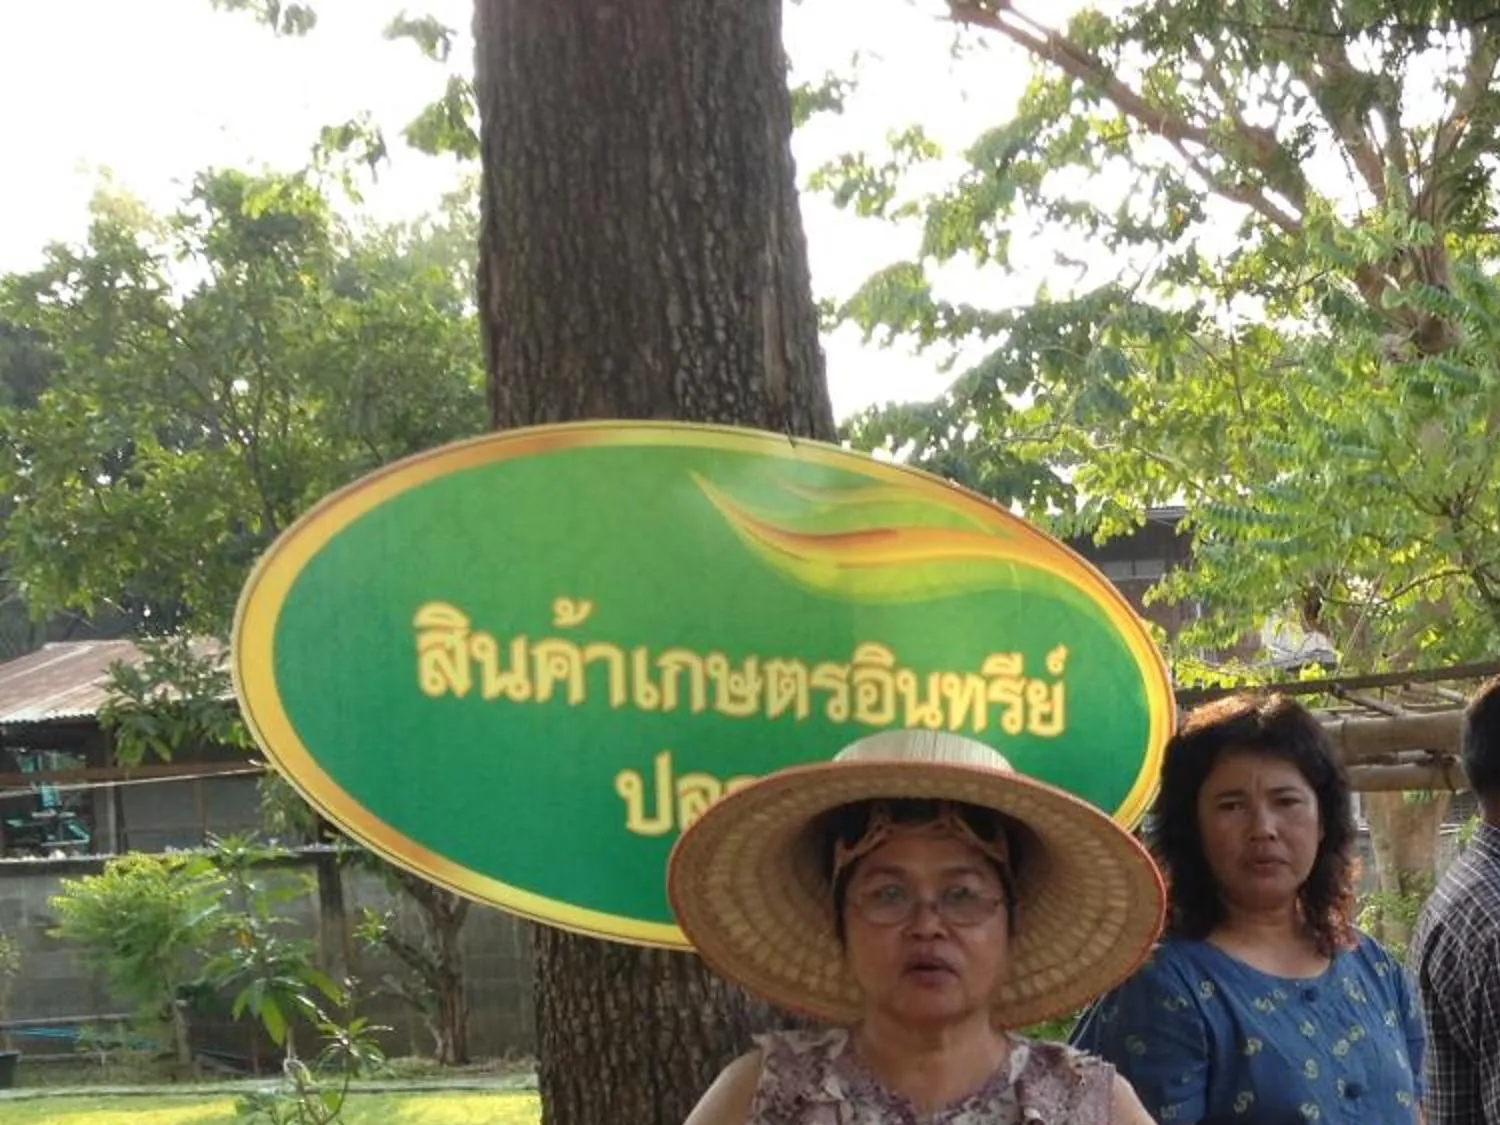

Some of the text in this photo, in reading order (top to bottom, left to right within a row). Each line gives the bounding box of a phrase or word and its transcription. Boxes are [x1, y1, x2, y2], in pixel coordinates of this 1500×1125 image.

[412, 597, 1068, 737] สินค้าเกษตรอินทรีย์
[613, 750, 760, 836] ปล
